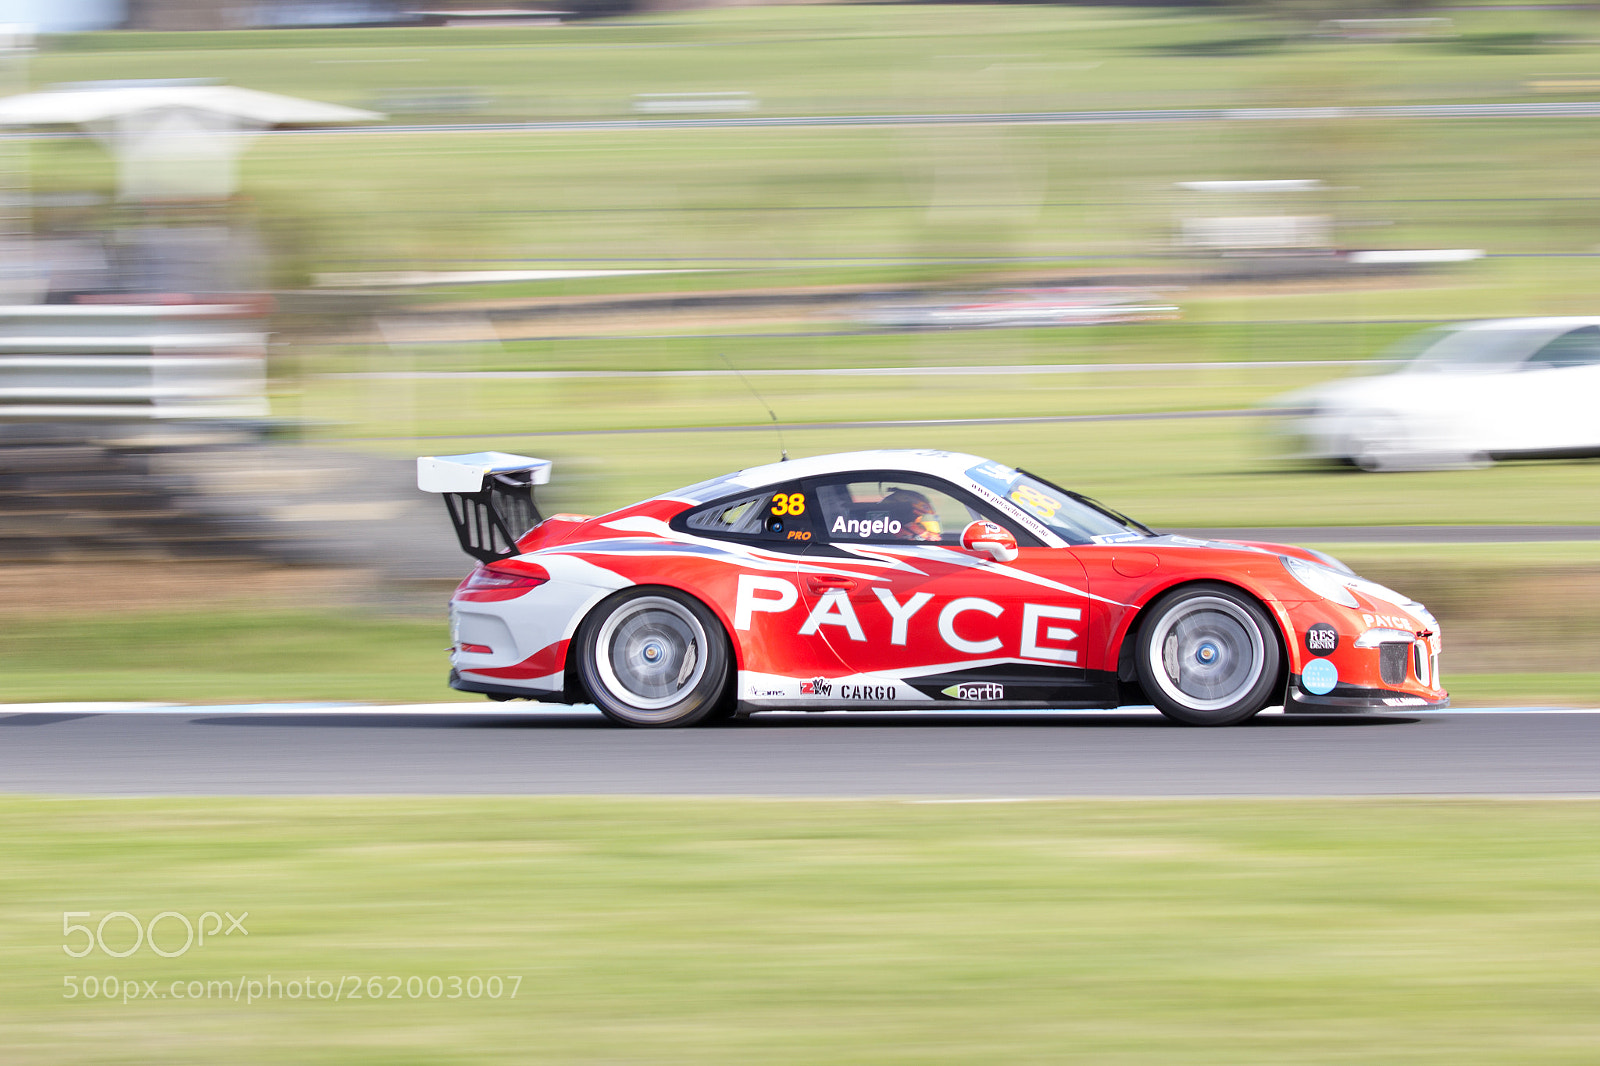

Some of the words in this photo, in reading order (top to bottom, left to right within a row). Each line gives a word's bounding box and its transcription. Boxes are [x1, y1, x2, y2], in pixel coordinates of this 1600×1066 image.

[771, 493, 805, 516] 38
[831, 516, 902, 538] Angelo
[787, 530, 812, 541] PRO
[734, 574, 1082, 663] PAYCE
[1362, 614, 1413, 630] PAYCE
[1309, 629, 1336, 642] RES
[841, 685, 896, 700] CARGO
